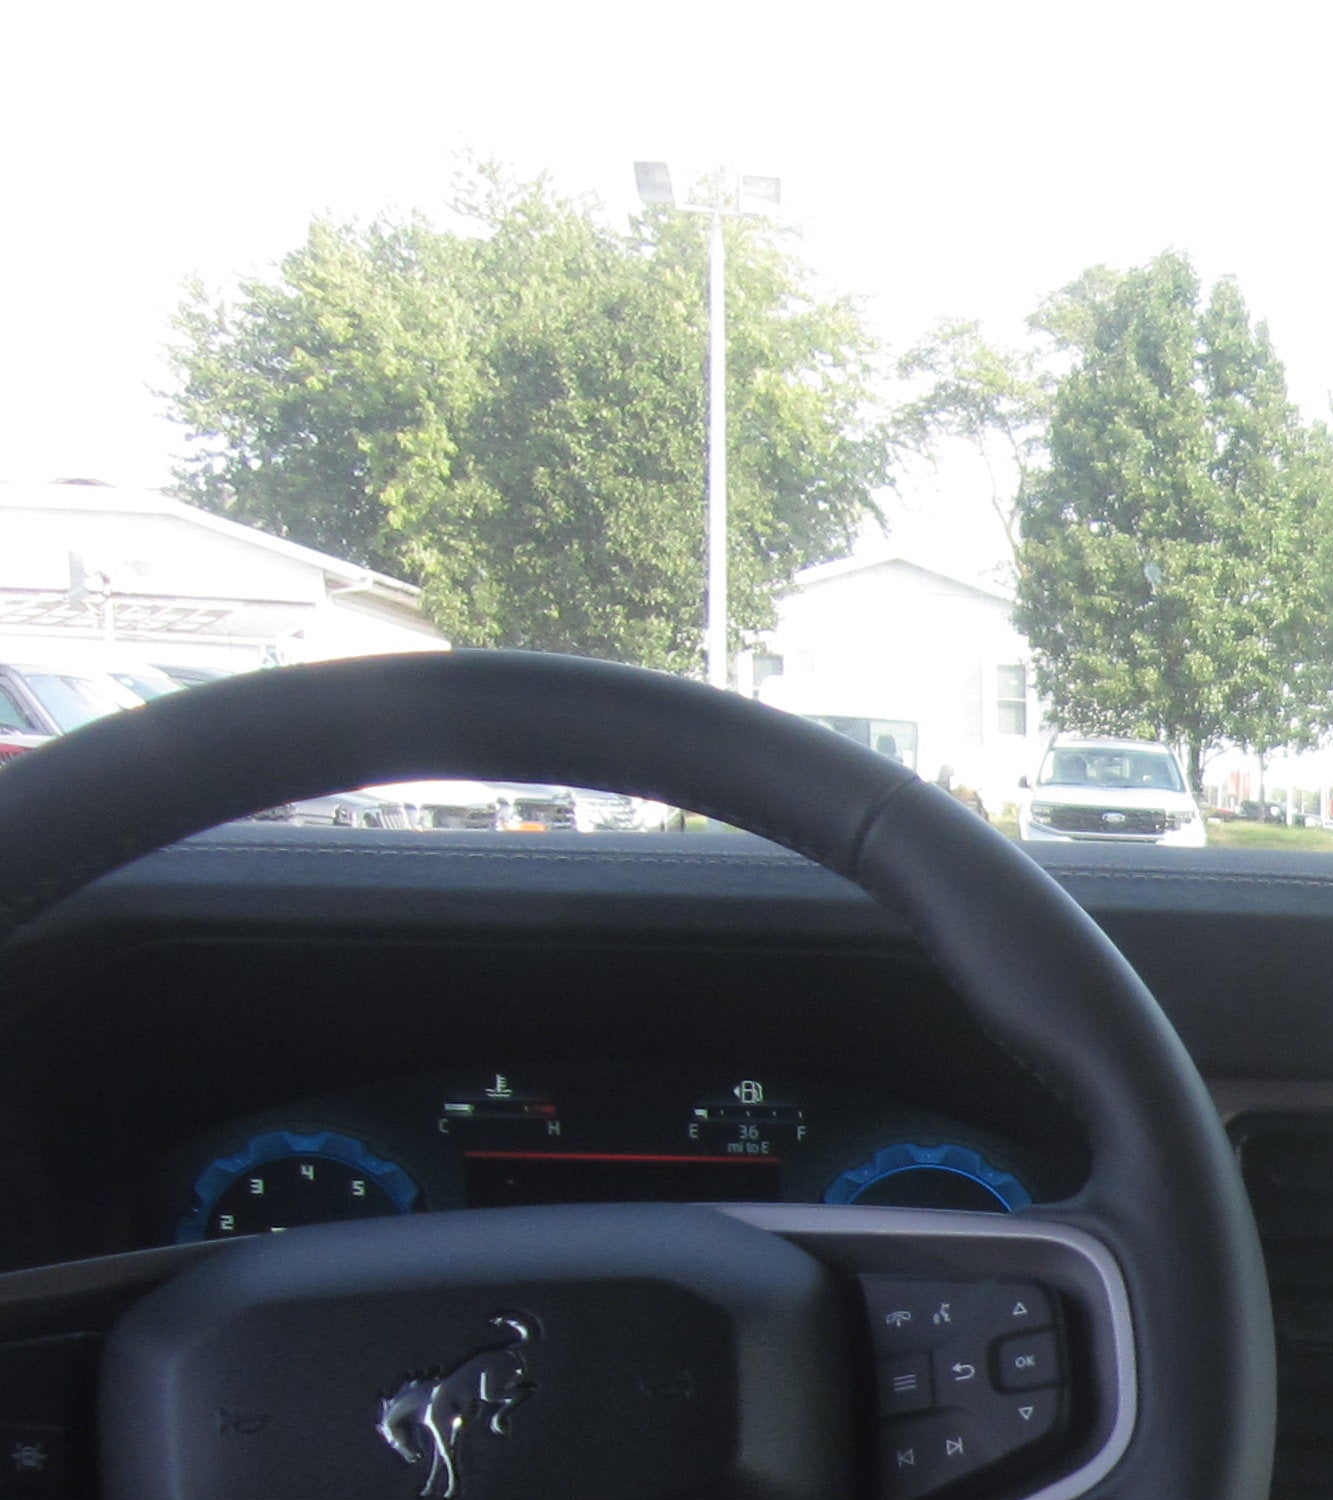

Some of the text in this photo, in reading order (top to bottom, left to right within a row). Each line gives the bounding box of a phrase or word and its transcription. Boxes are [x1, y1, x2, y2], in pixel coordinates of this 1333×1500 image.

[549, 1121, 560, 1136] H
[689, 1124, 699, 1139] E
[738, 1124, 760, 1139] 36
[797, 1125, 807, 1140] F
[761, 1141, 769, 1154] E
[301, 1164, 314, 1180] 4
[251, 1179, 264, 1194] 3
[352, 1180, 365, 1196] 5
[220, 1215, 234, 1230] 2
[1015, 1355, 1036, 1368] OK
